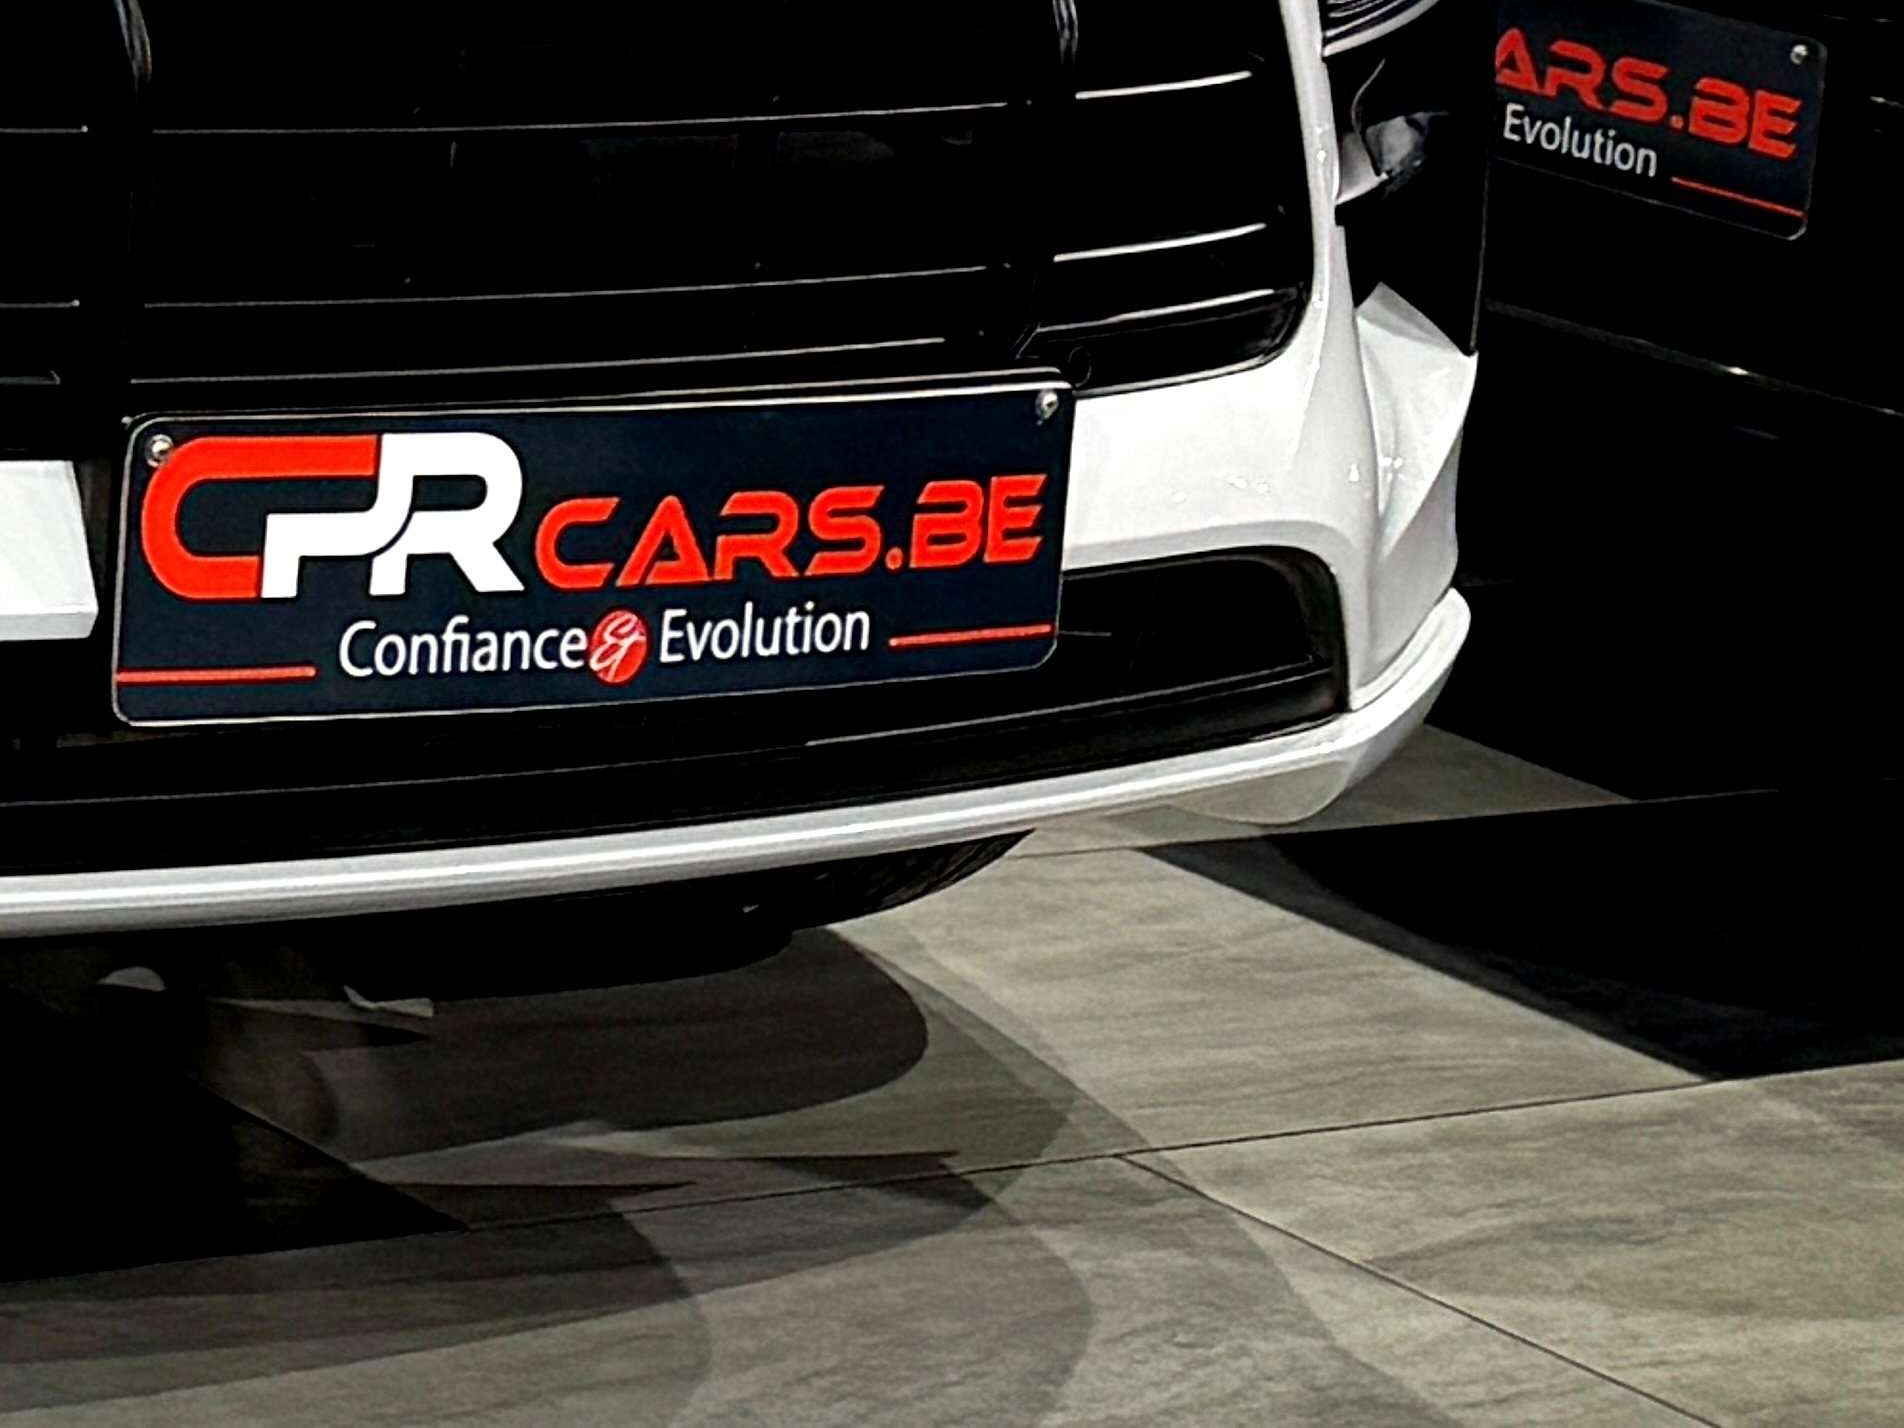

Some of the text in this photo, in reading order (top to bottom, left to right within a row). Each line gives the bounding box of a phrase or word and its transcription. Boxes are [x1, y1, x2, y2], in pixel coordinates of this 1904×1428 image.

[1494, 28, 1802, 161] ARS.BE
[1503, 102, 1658, 178] Evolution
[140, 431, 1048, 601] CPR CARS.BE
[338, 614, 589, 678] Confiance
[658, 599, 871, 664] Evolution
